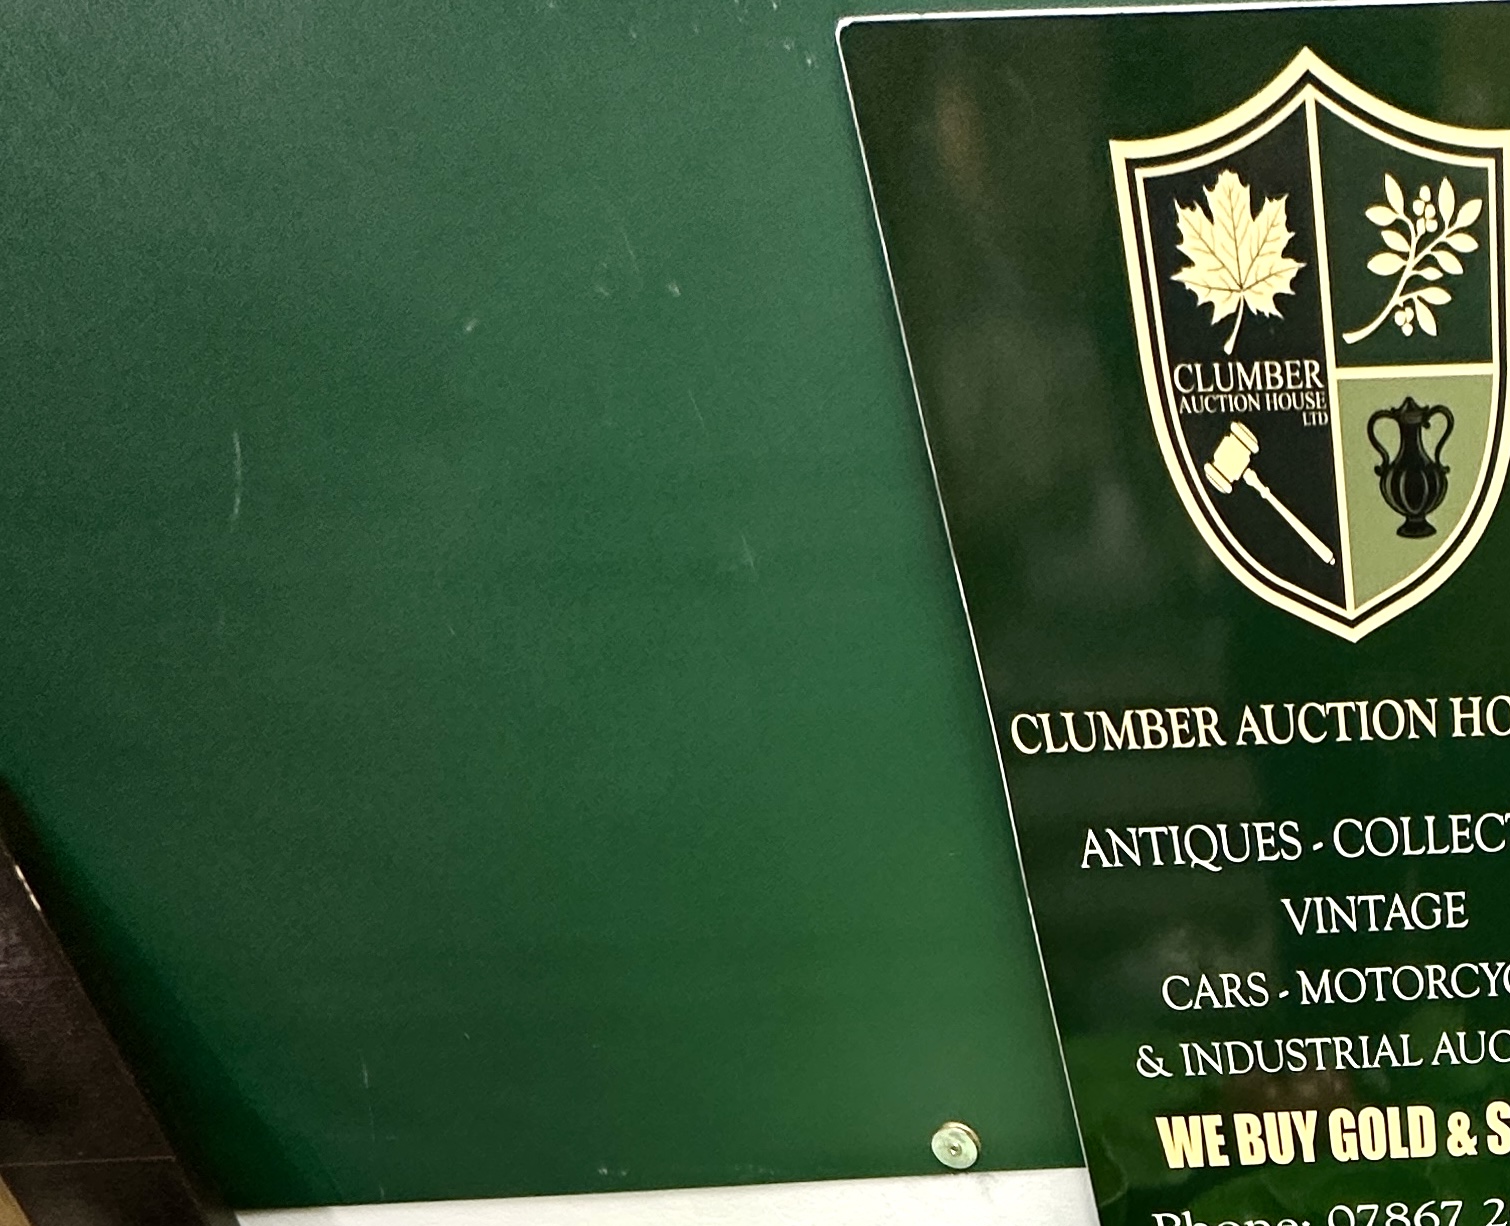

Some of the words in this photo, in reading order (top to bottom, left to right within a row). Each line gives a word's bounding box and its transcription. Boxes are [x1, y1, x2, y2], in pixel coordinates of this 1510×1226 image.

[1173, 359, 1325, 394] CLUMBER
[1179, 393, 1261, 414] AUCTION
[1265, 391, 1327, 411] HOUSE
[1302, 411, 1329, 427] LTD
[1011, 706, 1227, 755] CLUMBER
[1235, 697, 1438, 746] AUCTION
[1080, 820, 1303, 872] ANTIQUES
[1280, 890, 1470, 935] VINTAGE
[1161, 971, 1270, 1011] CARS
[1136, 1044, 1173, 1078] &
[1183, 1033, 1424, 1077] INDUSTRIAL
[1155, 1114, 1230, 1169] WE
[1234, 1109, 1318, 1166] BUY
[1328, 1105, 1437, 1163] GOLD
[1446, 1111, 1478, 1157] &
